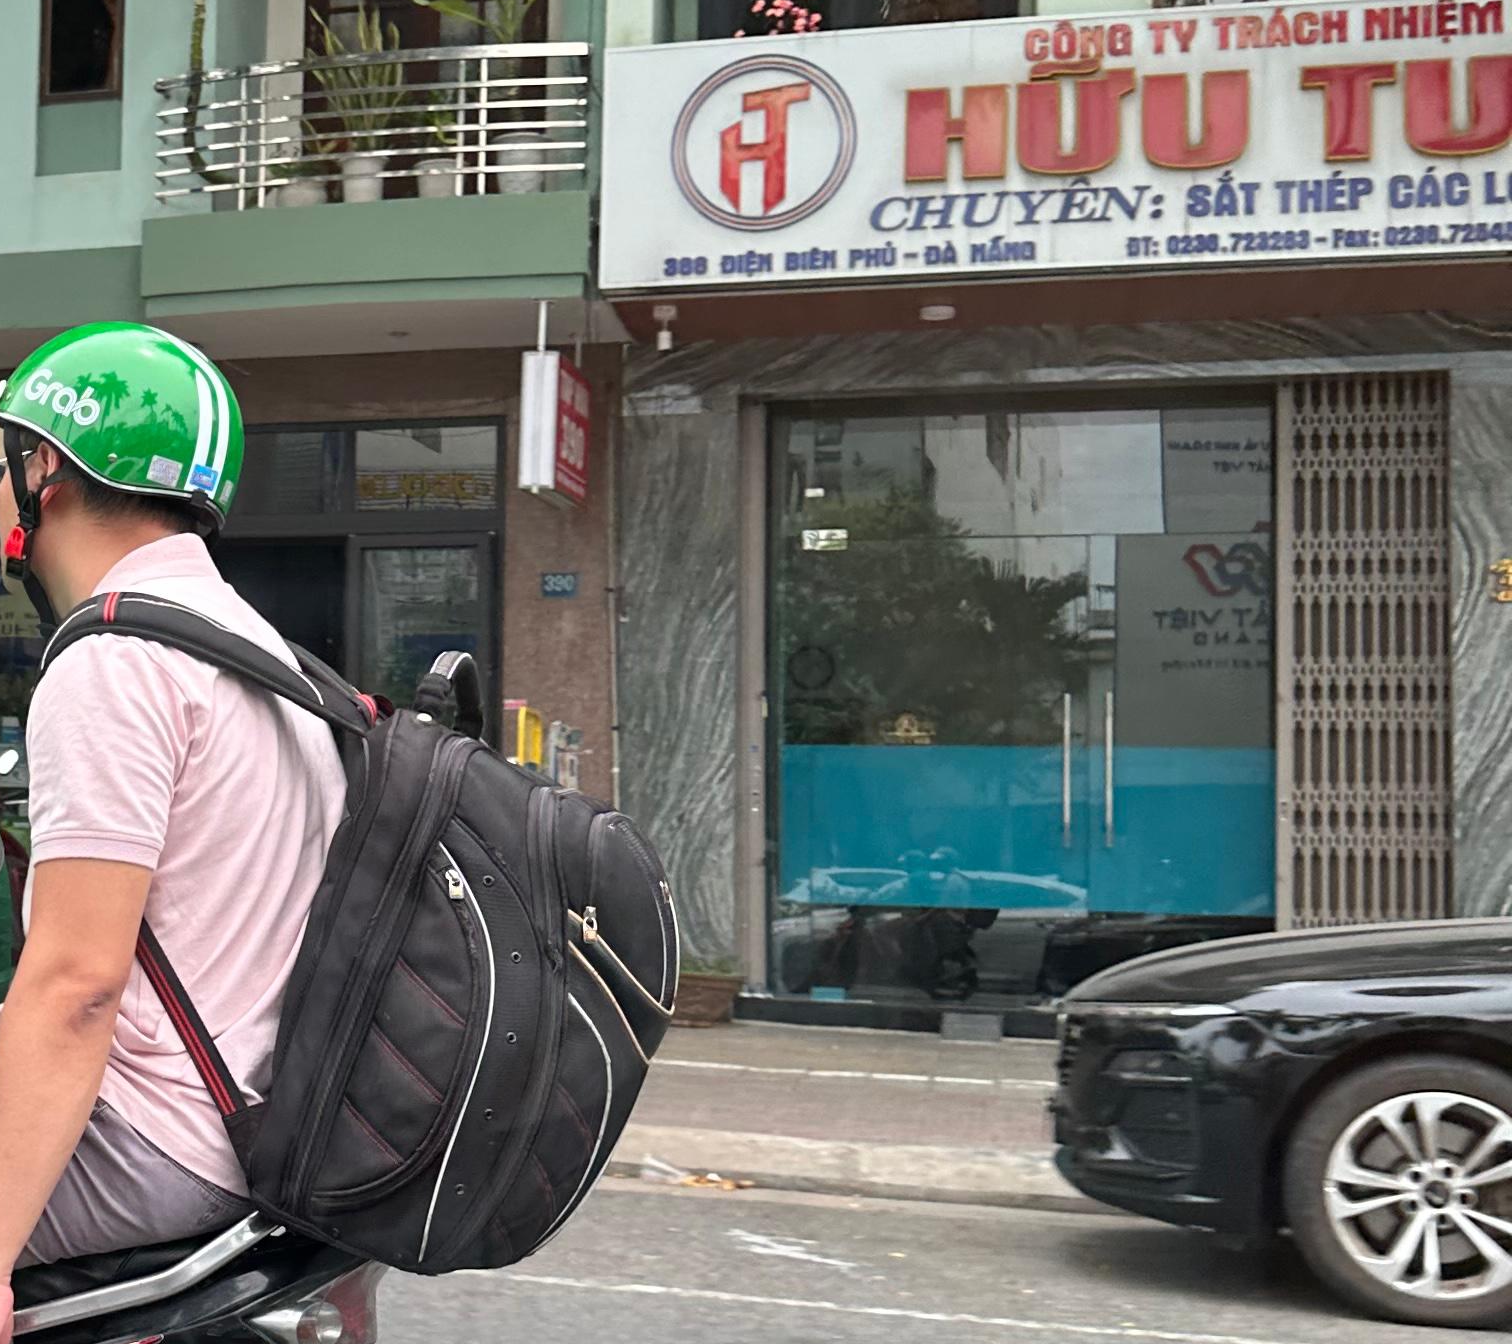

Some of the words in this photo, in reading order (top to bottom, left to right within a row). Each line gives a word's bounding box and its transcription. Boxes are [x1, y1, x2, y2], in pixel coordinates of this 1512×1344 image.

[1023, 19, 1133, 64] CÔNG
[1149, 17, 1197, 55] TY
[1212, 6, 1348, 51] TRÁCH
[903, 60, 1251, 183] HỮU
[868, 176, 1165, 232] CHUYÊN:
[1186, 171, 1261, 218] SẮT
[1274, 169, 1374, 214] THÉP
[1388, 165, 1471, 211] CÁC
[720, 249, 773, 280] ĐIỆN
[784, 245, 838, 272] BIÊN
[923, 242, 958, 266] ĐÀ
[1332, 227, 1381, 250] Fax:
[22, 366, 101, 427] Grab
[543, 574, 575, 592] 390
